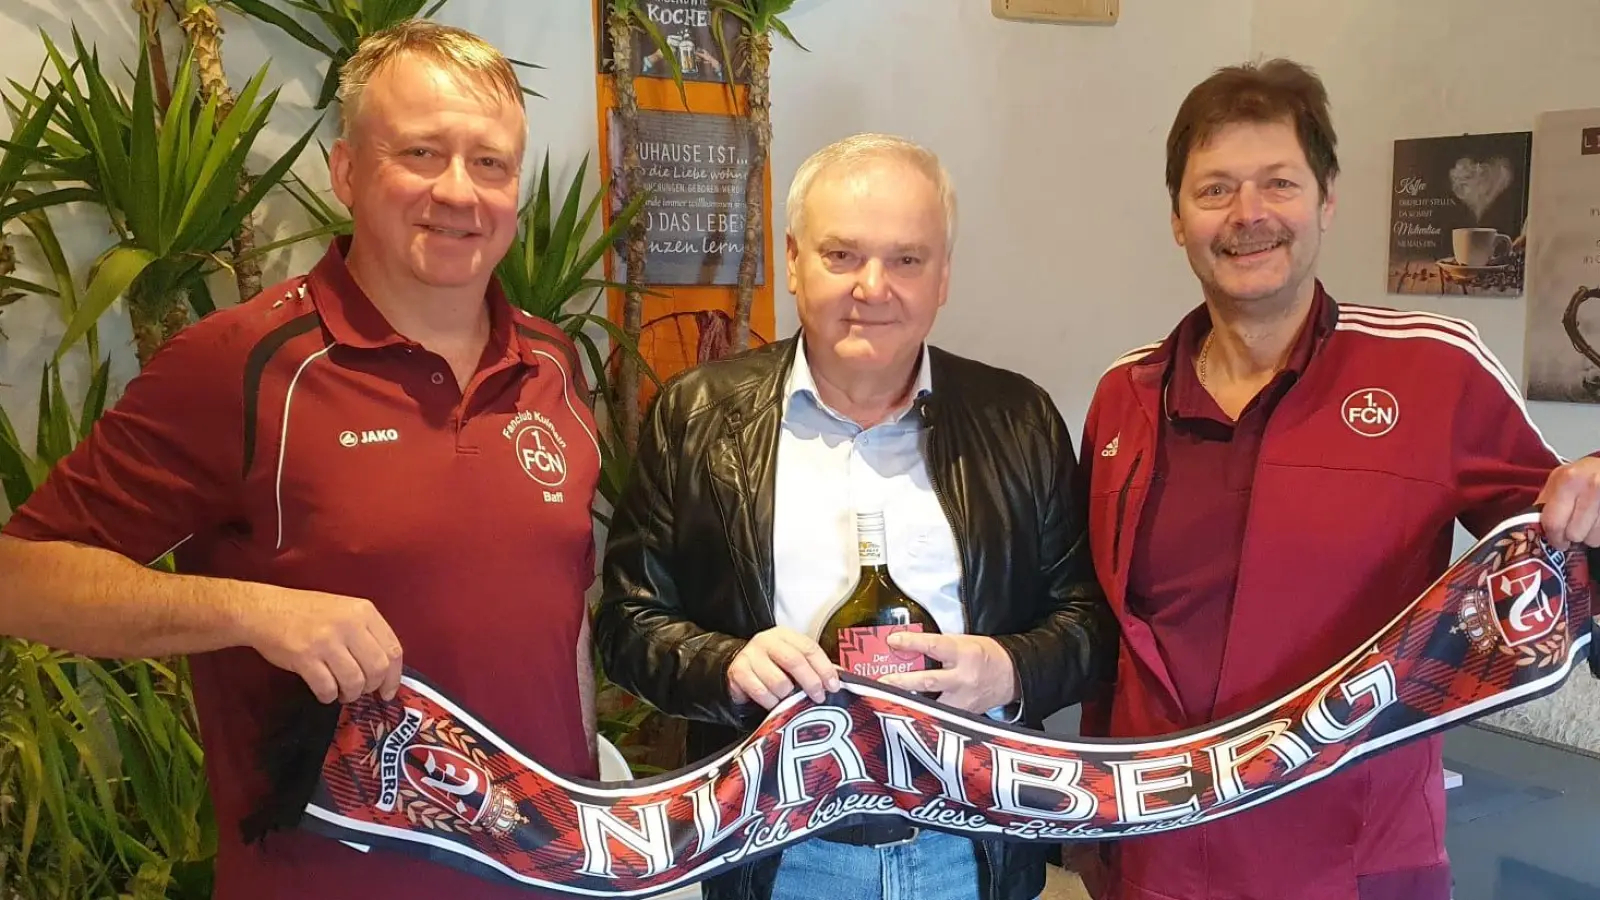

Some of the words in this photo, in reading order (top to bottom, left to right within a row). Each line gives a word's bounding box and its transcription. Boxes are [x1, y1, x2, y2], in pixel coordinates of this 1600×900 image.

[636, 142, 702, 162] UHAUSE
[648, 165, 670, 178] die
[673, 166, 708, 180] Liebe
[659, 211, 691, 232] DAS
[648, 240, 699, 254] nzen
[702, 236, 744, 254] lern
[1363, 392, 1377, 408] 1.
[502, 409, 532, 440] Fanclub
[1348, 407, 1393, 425] FCN
[361, 428, 399, 444] JAKO
[531, 430, 546, 450] 1.
[522, 448, 564, 474] FCN
[873, 653, 889, 663] Der
[853, 661, 914, 677] Silvaner
[382, 712, 420, 806] NÜRNBERG
[569, 645, 1399, 879] NÜRNBERG
[724, 808, 791, 863] Ich
[806, 793, 895, 829] bereue
[910, 798, 987, 828] diese
[1003, 819, 1105, 840] Liebe
